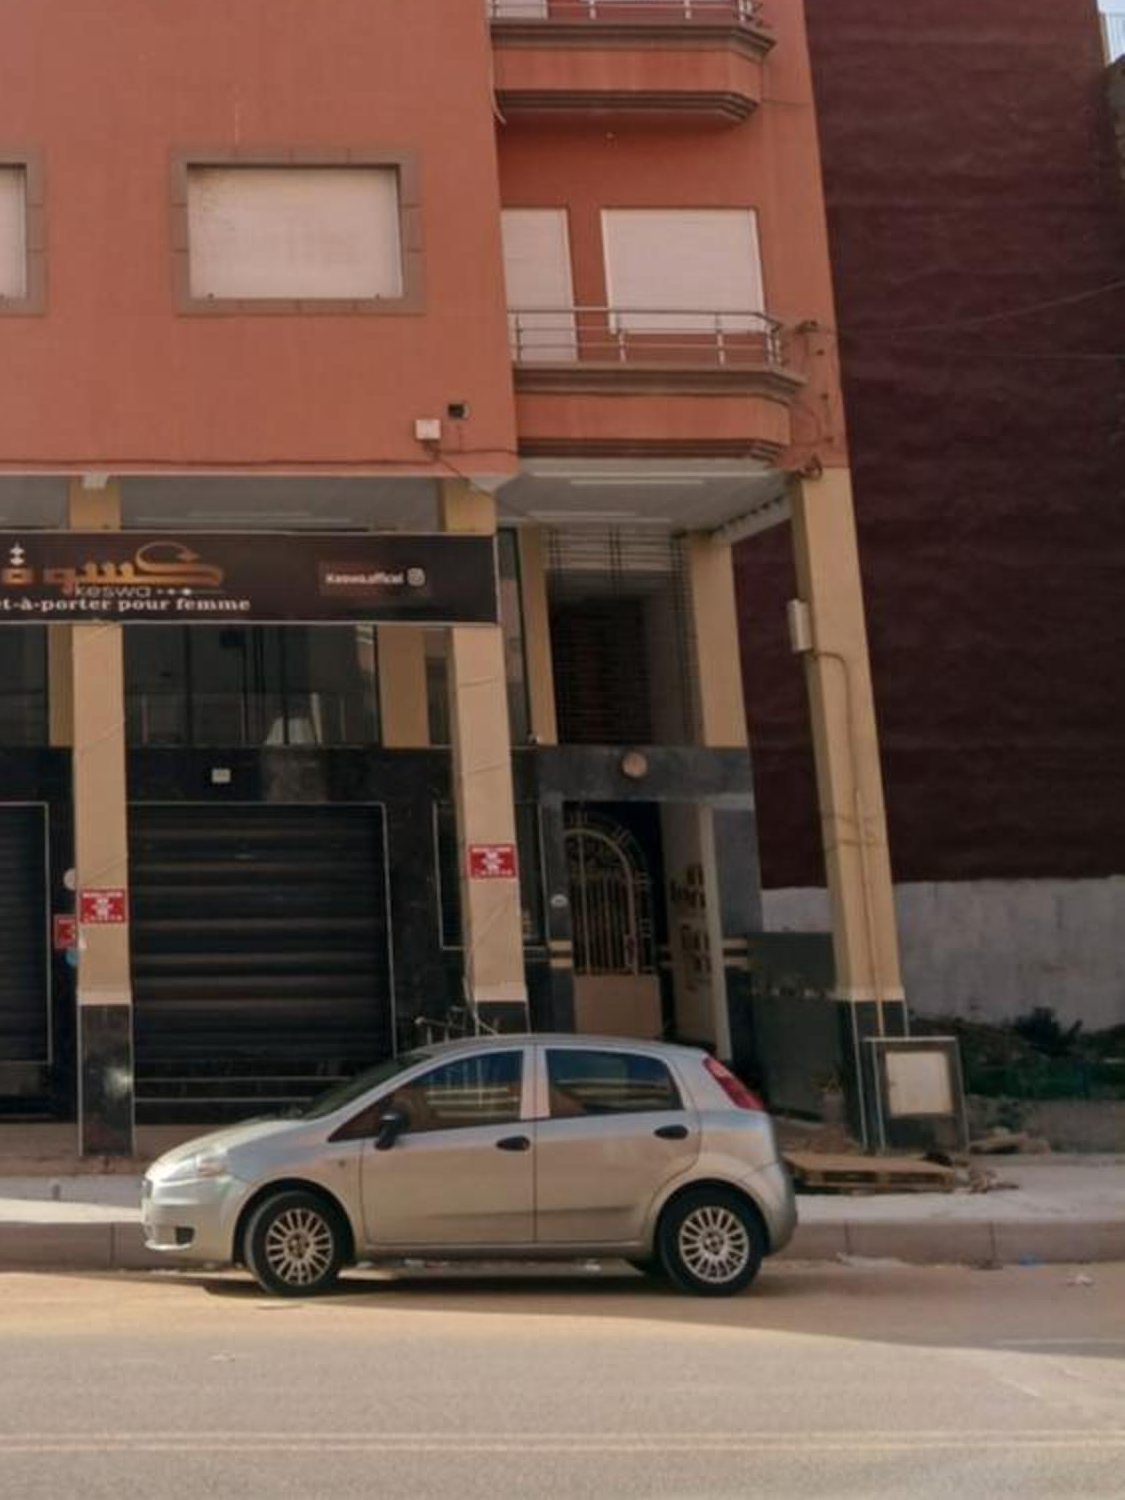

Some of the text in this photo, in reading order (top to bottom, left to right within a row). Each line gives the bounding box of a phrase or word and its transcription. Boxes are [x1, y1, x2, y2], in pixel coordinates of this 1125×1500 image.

[0, 541, 224, 596] كسوة
[75, 585, 151, 598] keswa
[119, 599, 169, 612] pour
[176, 596, 251, 610] femme
